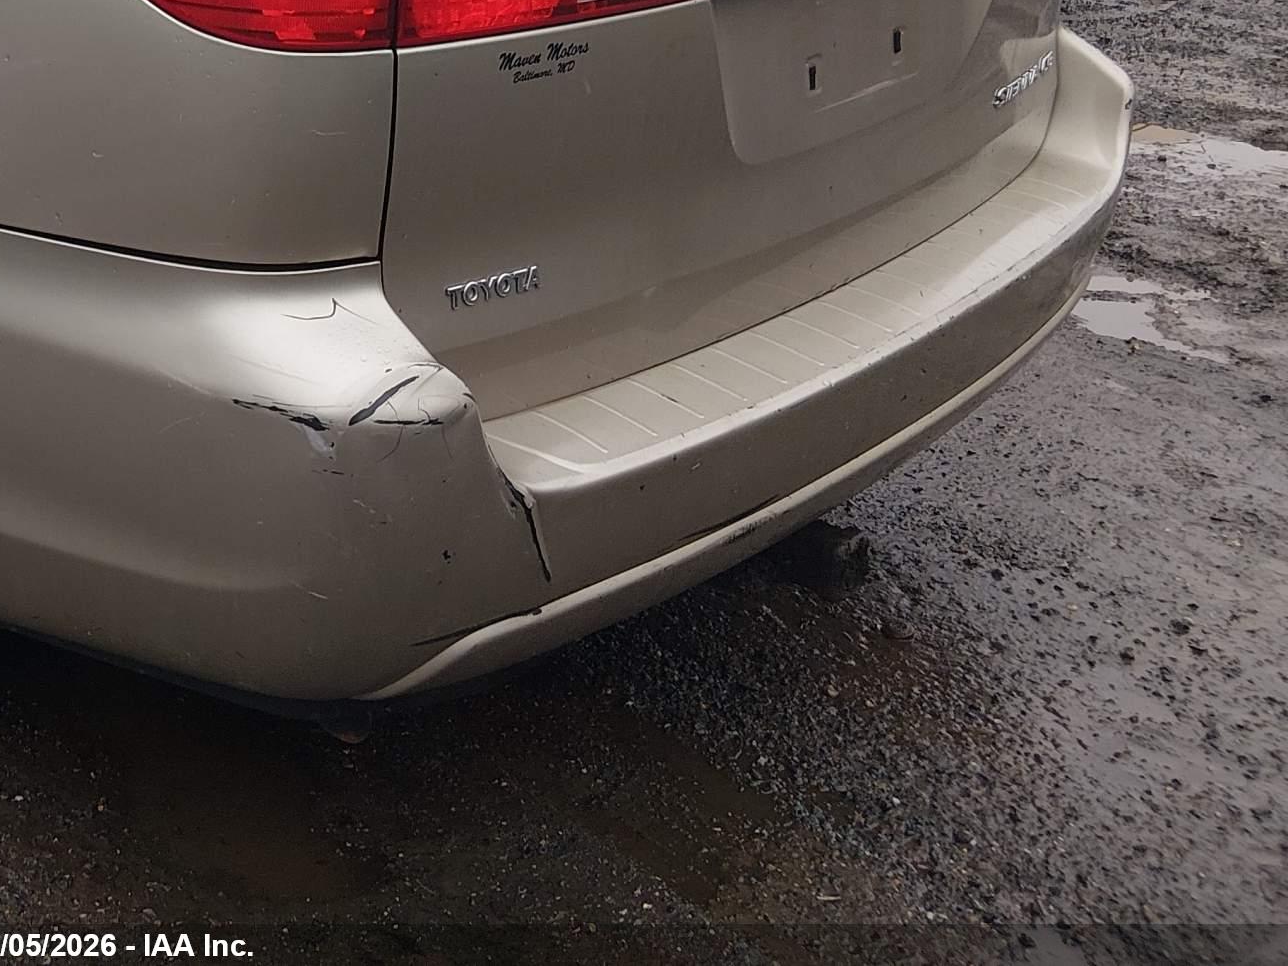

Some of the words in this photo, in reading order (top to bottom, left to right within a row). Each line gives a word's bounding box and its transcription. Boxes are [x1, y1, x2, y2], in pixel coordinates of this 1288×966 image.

[499, 52, 542, 71] Maven
[546, 41, 590, 61] Motors
[557, 60, 576, 74] MD
[445, 264, 539, 311] TOYOTA
